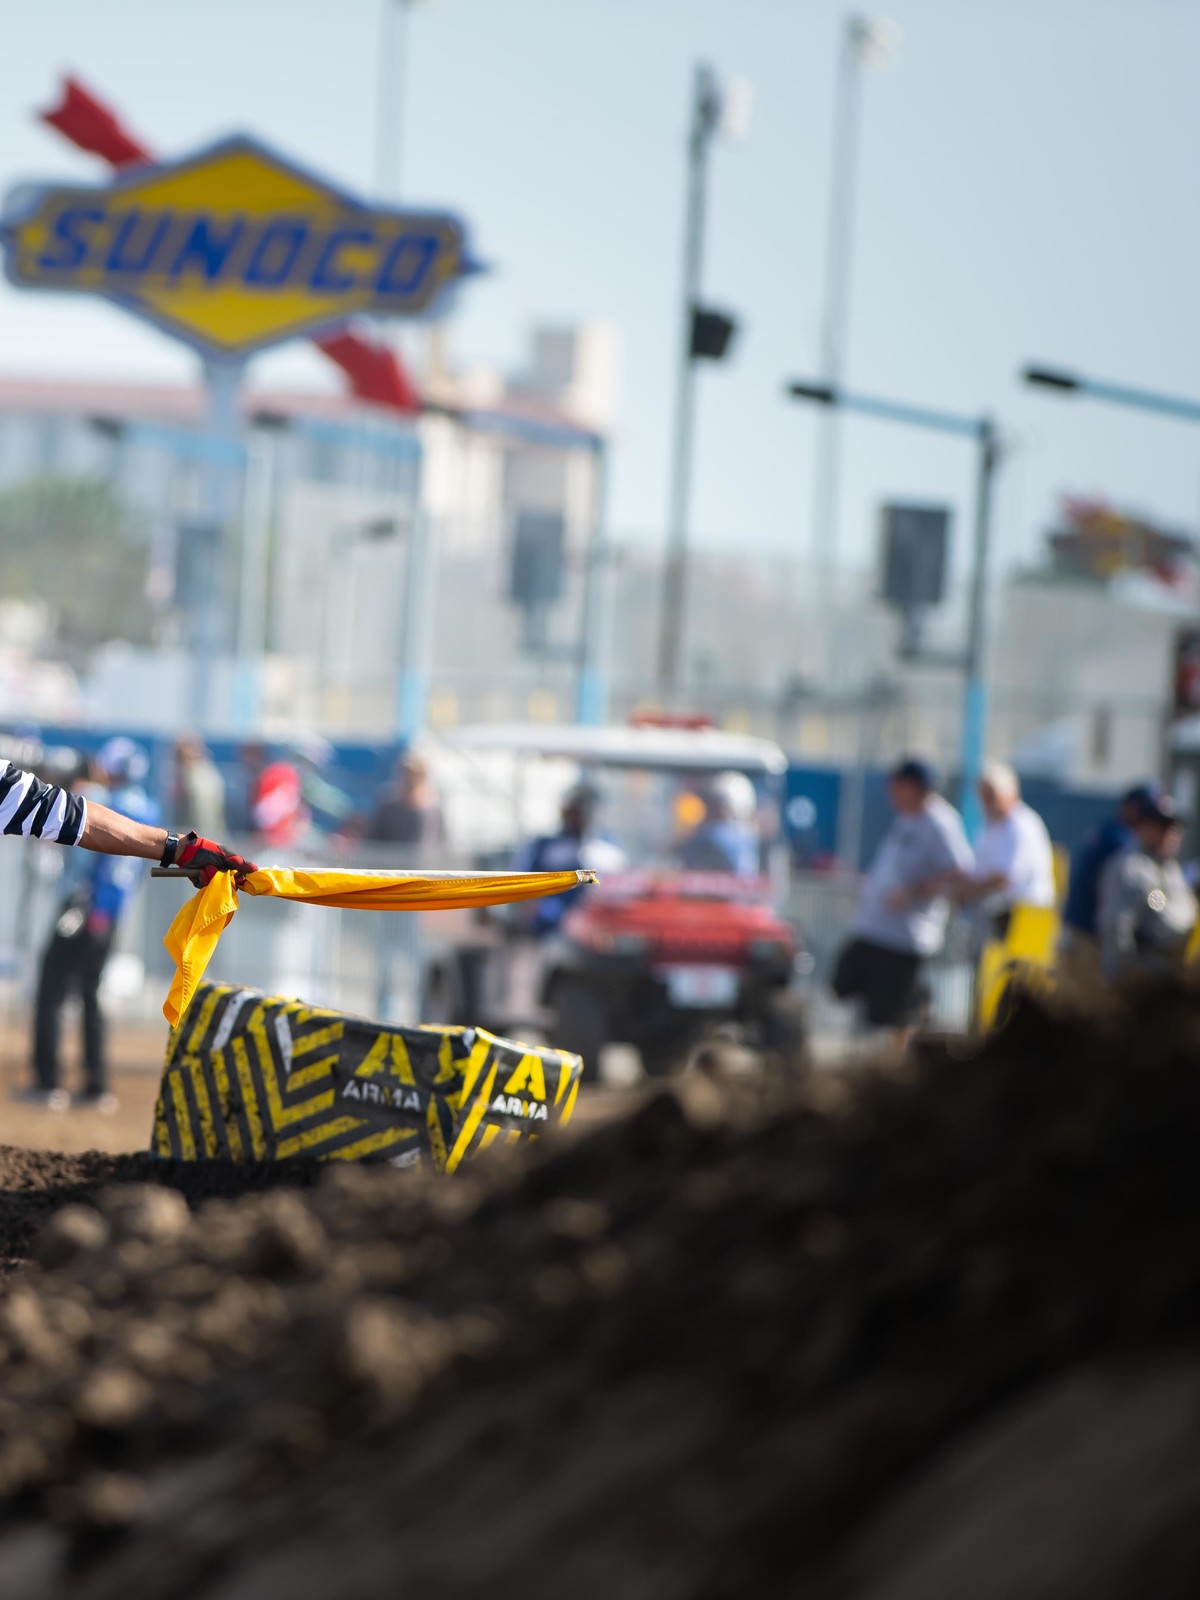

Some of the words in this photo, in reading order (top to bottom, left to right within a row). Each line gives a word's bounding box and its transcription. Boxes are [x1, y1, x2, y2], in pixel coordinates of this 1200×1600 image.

[39, 207, 440, 295] SUNOCO
[342, 1080, 421, 1112] ARMA
[492, 1094, 549, 1121] ARMA
